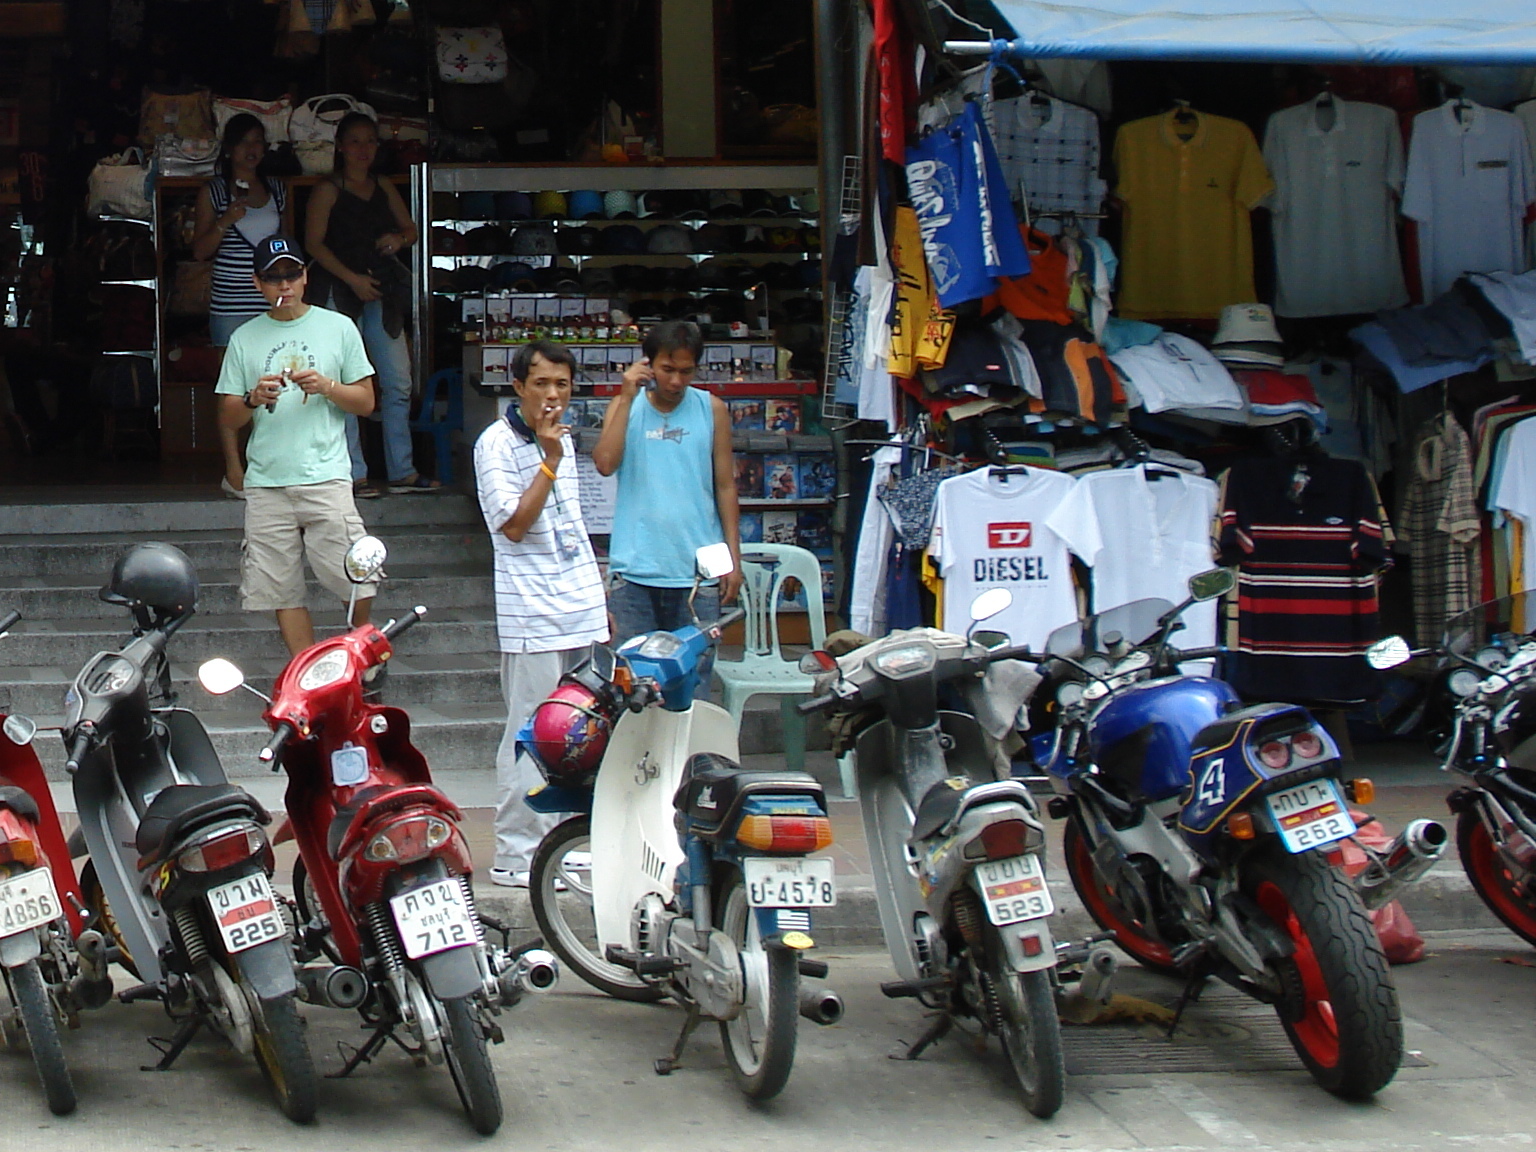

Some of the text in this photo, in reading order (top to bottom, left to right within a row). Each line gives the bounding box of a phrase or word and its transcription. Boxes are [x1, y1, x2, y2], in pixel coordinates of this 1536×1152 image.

[974, 556, 1049, 582] DIESEL
[1198, 758, 1226, 806] 4
[1295, 818, 1343, 846] 262
[995, 896, 1045, 921] 523
[229, 916, 278, 948] 225
[416, 924, 467, 952] 712
